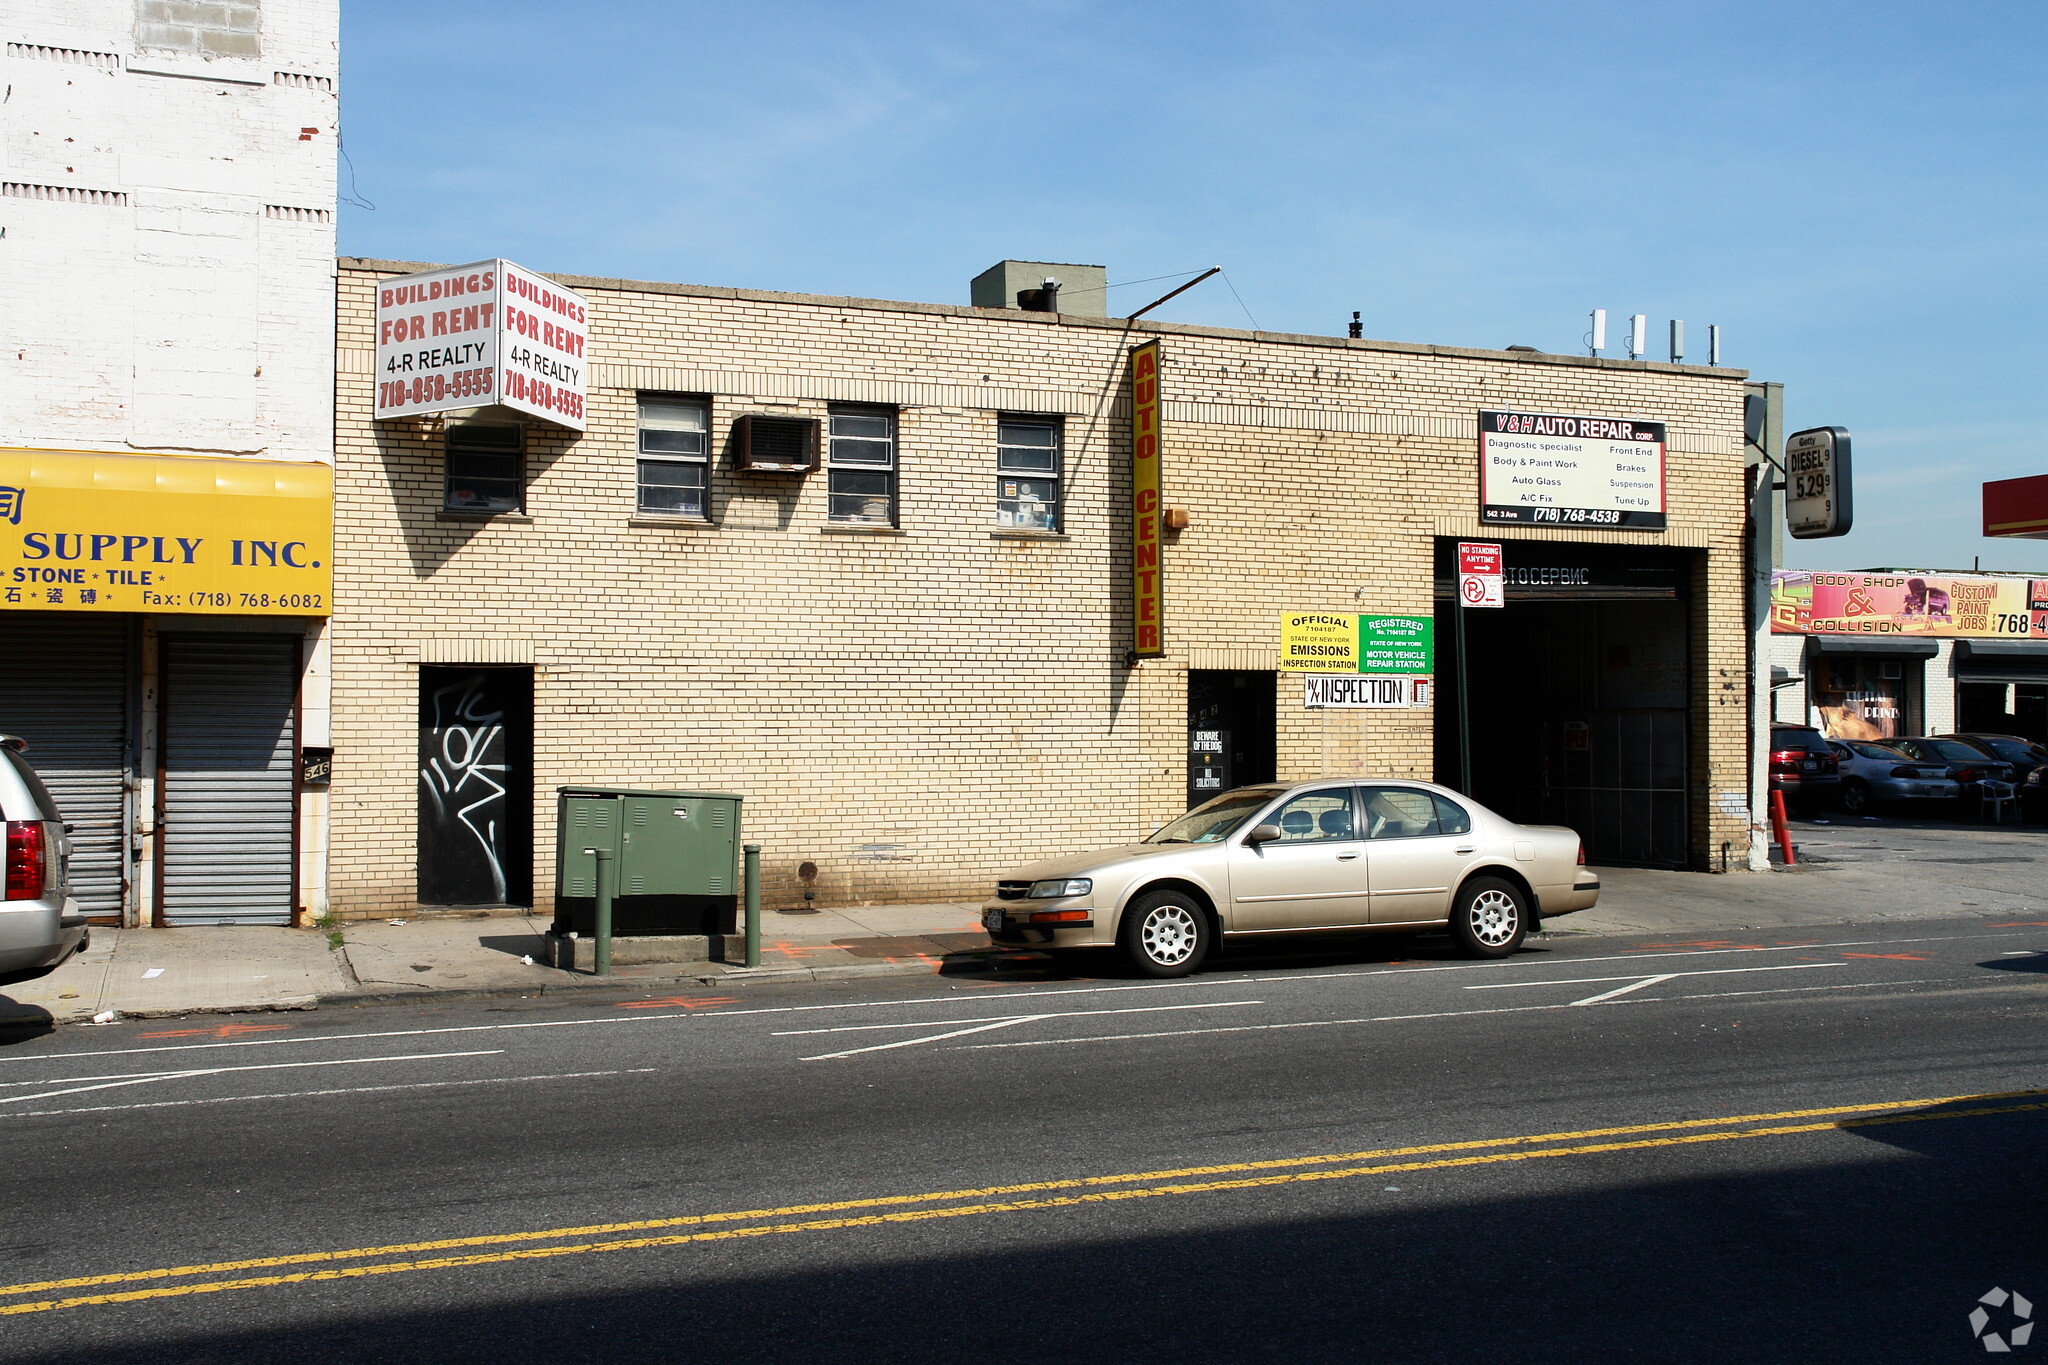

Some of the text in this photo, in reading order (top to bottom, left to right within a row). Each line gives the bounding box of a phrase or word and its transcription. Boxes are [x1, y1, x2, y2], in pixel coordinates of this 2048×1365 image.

[381, 272, 494, 308] BUILDINGS
[507, 272, 585, 324] BUILDINGS
[381, 302, 494, 345] FOR RENT
[506, 305, 584, 358] FOR RENT
[387, 342, 486, 374] 4-R REALTY
[511, 345, 579, 386] 4-R REALTY
[379, 367, 493, 408] 718-858-5555
[505, 369, 583, 420] 718-858-5555
[1535, 417, 1576, 436] AUTO
[1580, 422, 1633, 440] REPAIR
[1635, 432, 1654, 441] CORP.
[1488, 439, 1582, 452] Diagnostic specialist
[1799, 437, 1816, 447] Getty
[1610, 446, 1653, 456] Front End
[1493, 457, 1578, 469] Body & Paint Work
[1791, 449, 1830, 472] DIESEL 9
[1616, 464, 1646, 473] Brakes
[1512, 476, 1562, 486] Auto Glass
[1610, 479, 1654, 489] Suspension
[1796, 473, 1831, 497] 5.29 9
[1136, 352, 1158, 649] AUTO CENTER
[1521, 494, 1553, 503] A/C Fix
[1615, 496, 1650, 506] Tune Up
[1825, 500, 1831, 512] 9
[1486, 510, 1498, 518] 542
[1505, 511, 1518, 519] Ave
[1534, 508, 1620, 523] (718) 768-4538
[22, 532, 321, 568] SUPPLY INC.
[1471, 547, 1498, 555] STANDING
[1466, 555, 1495, 564] ANYTIME
[12, 567, 152, 585] STONE TILE
[1815, 575, 1905, 588] BODY SHOP
[5, 587, 22, 603] 石
[1951, 582, 1997, 600] CUSTOM
[143, 590, 322, 608] Fax: (718) 768-6082
[1843, 586, 1876, 618] &
[1957, 601, 1989, 615] PAINT
[1291, 615, 1349, 629] OFFICIAL
[1368, 619, 1424, 631] REGISTERED
[1813, 620, 1902, 632] COLLISION
[1957, 617, 1987, 630] JOBS
[1290, 645, 1350, 657] EMISSIONS
[1366, 650, 1426, 659] MOTOR VEHICLE
[1283, 660, 1357, 669] INSPECTION STATION
[1367, 660, 1426, 668] REPAIR STATION
[1321, 679, 1403, 703] INSPECTION
[1864, 707, 1900, 718] PRINTS
[1196, 731, 1219, 741] BEWARE
[1193, 741, 1222, 750] OF THE DOG
[305, 763, 329, 779] 546
[1196, 777, 1220, 788] SOLICITORS
